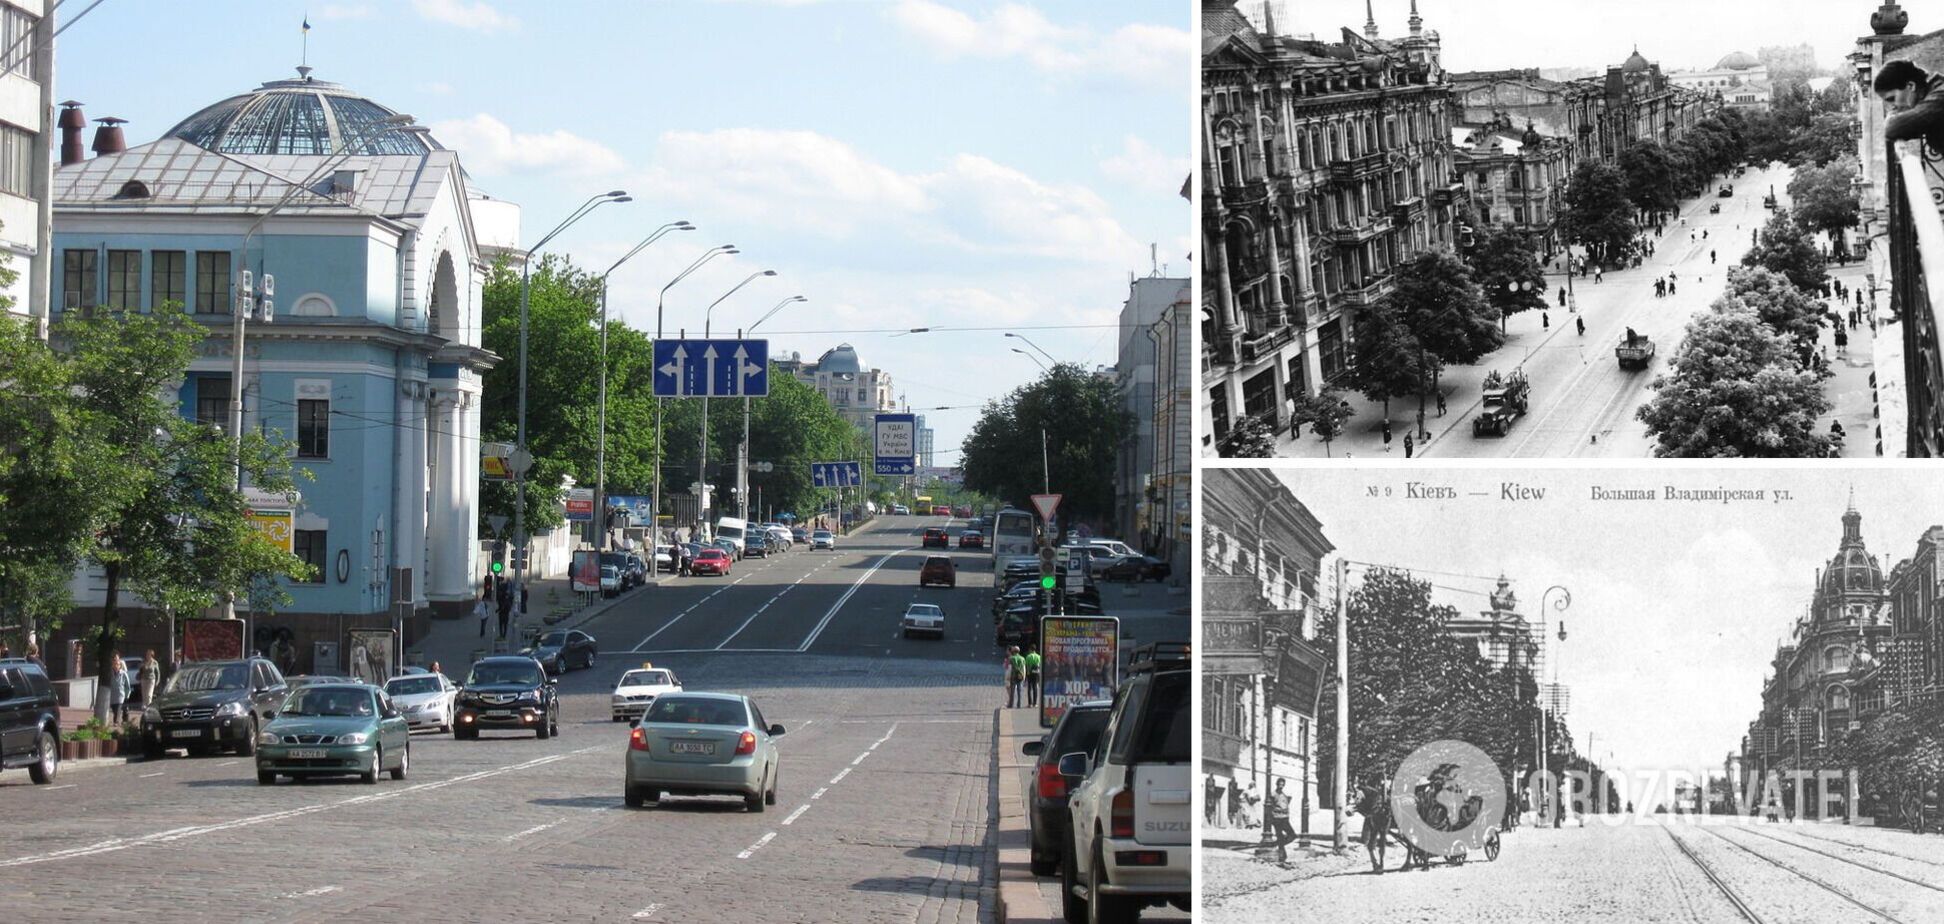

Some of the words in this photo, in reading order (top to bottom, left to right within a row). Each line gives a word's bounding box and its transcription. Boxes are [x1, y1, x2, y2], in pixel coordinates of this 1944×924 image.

[877, 464, 891, 472] 550
[1070, 559, 1079, 568] P
[1065, 680, 1090, 694] ХОР
